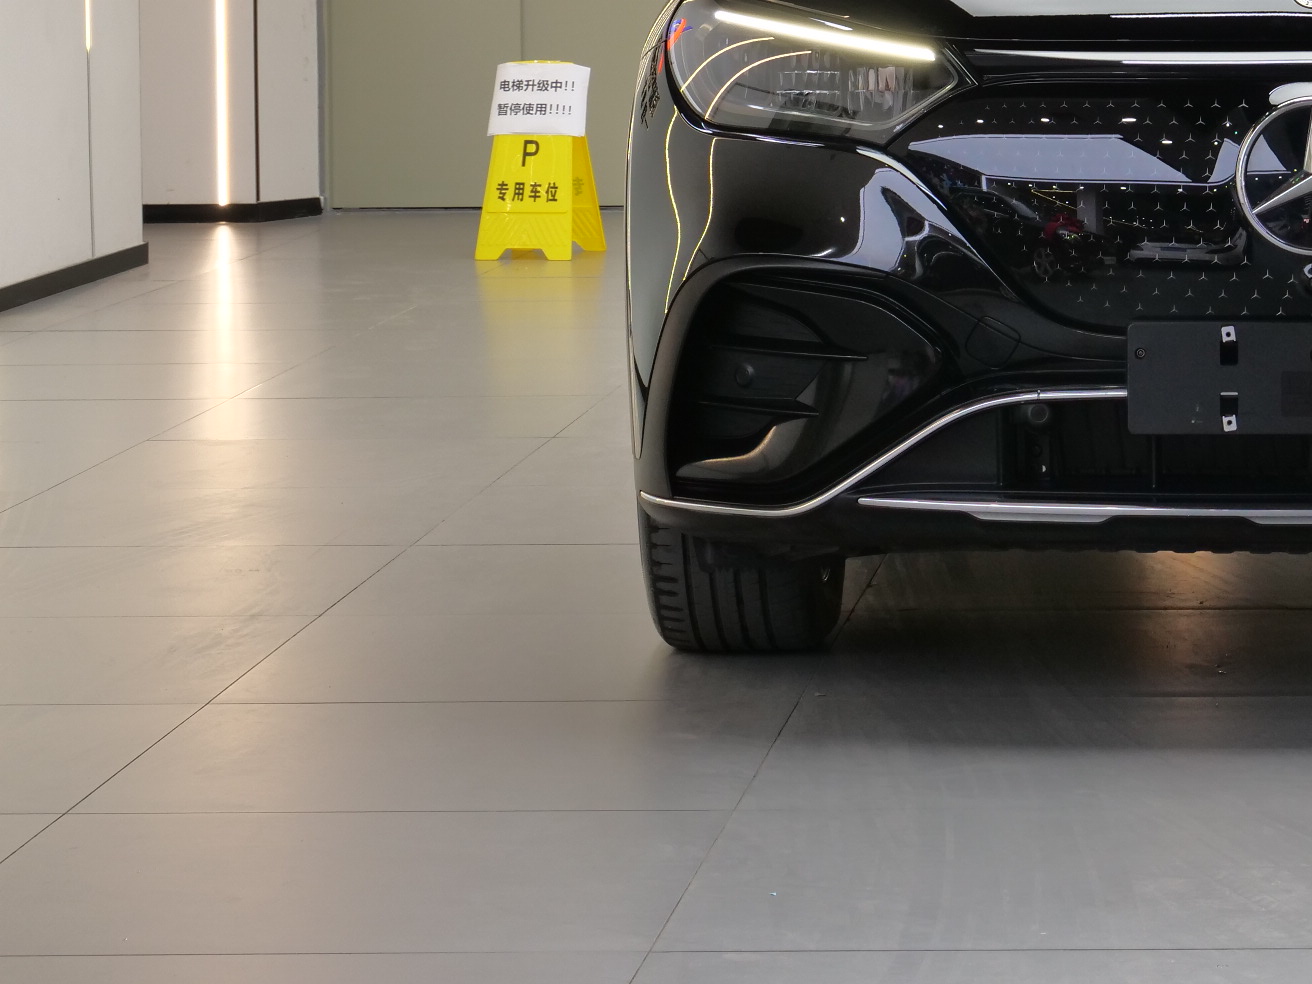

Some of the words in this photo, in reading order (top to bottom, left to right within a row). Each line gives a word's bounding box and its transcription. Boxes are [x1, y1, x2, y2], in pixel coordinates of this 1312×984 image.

[521, 139, 540, 167] P
[496, 180, 559, 203] 专用车位
